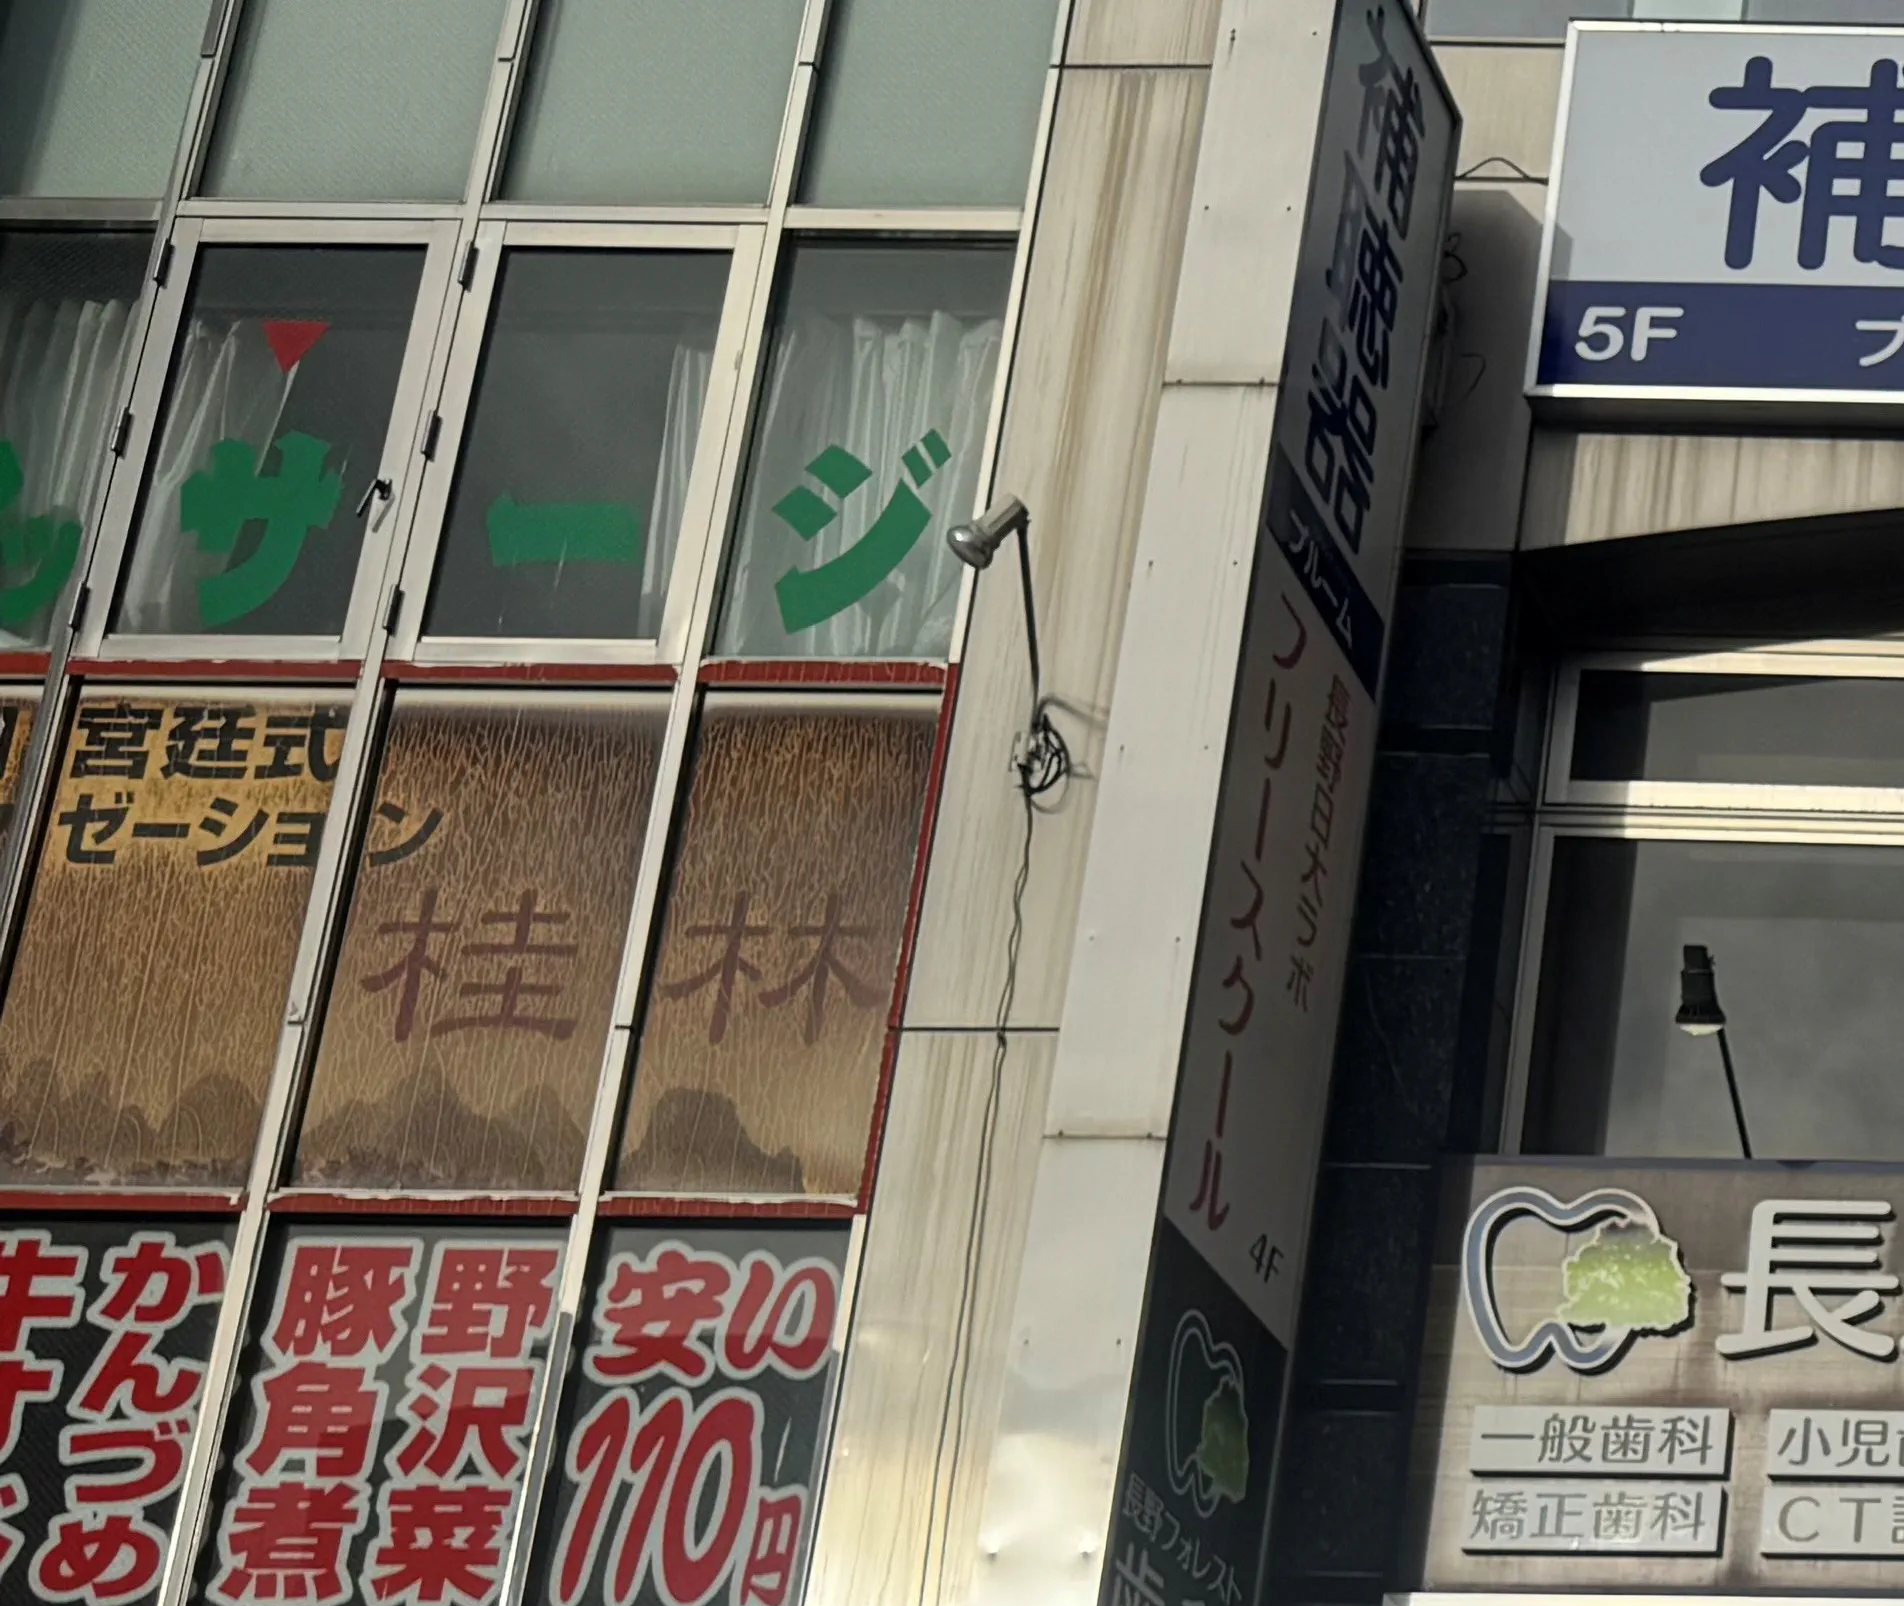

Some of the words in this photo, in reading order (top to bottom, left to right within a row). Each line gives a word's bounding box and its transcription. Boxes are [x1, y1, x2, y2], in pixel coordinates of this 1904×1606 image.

[1574, 306, 1685, 363] 5F
[1288, 507, 1357, 650] ブルーム
[0, 702, 349, 782] 宮廷式
[1190, 592, 1309, 1233] フリースクール
[1248, 1232, 1286, 1284] 4F
[592, 1240, 842, 1386] 安い
[34, 1236, 226, 1604] かんづめ
[1478, 1411, 1714, 1467] 一般歯科
[1121, 1471, 1243, 1606] 長野フォレスト
[1468, 1489, 1711, 1546] 矯正歯科
